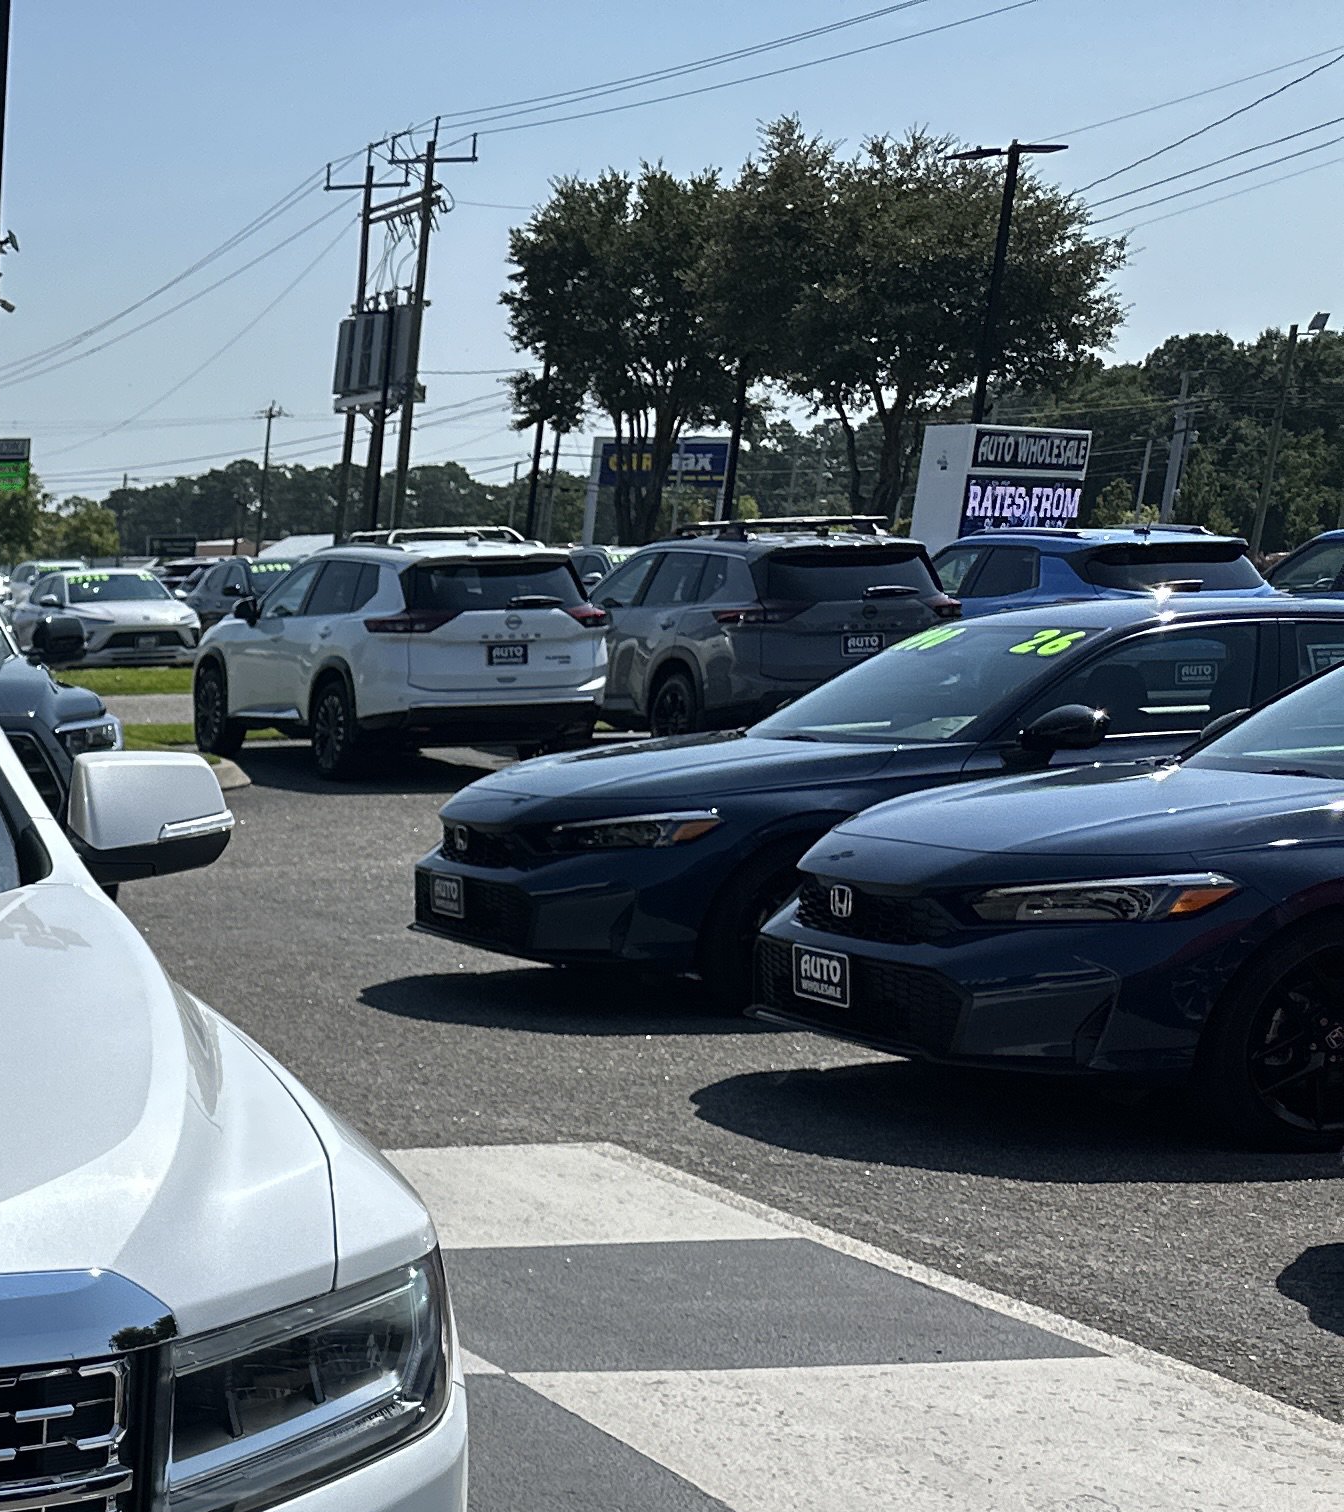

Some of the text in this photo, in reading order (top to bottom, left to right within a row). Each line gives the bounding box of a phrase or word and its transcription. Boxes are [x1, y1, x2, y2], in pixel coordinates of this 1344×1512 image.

[977, 436, 1086, 466] AUTO WHOLESALE
[966, 485, 1082, 518] RATES FROM
[493, 646, 523, 657] AUTO
[847, 636, 880, 648] AUTO
[1009, 629, 1086, 657] 26
[1181, 664, 1212, 676] AUTO
[434, 879, 458, 900] AUTO
[800, 954, 841, 983] AUTO
